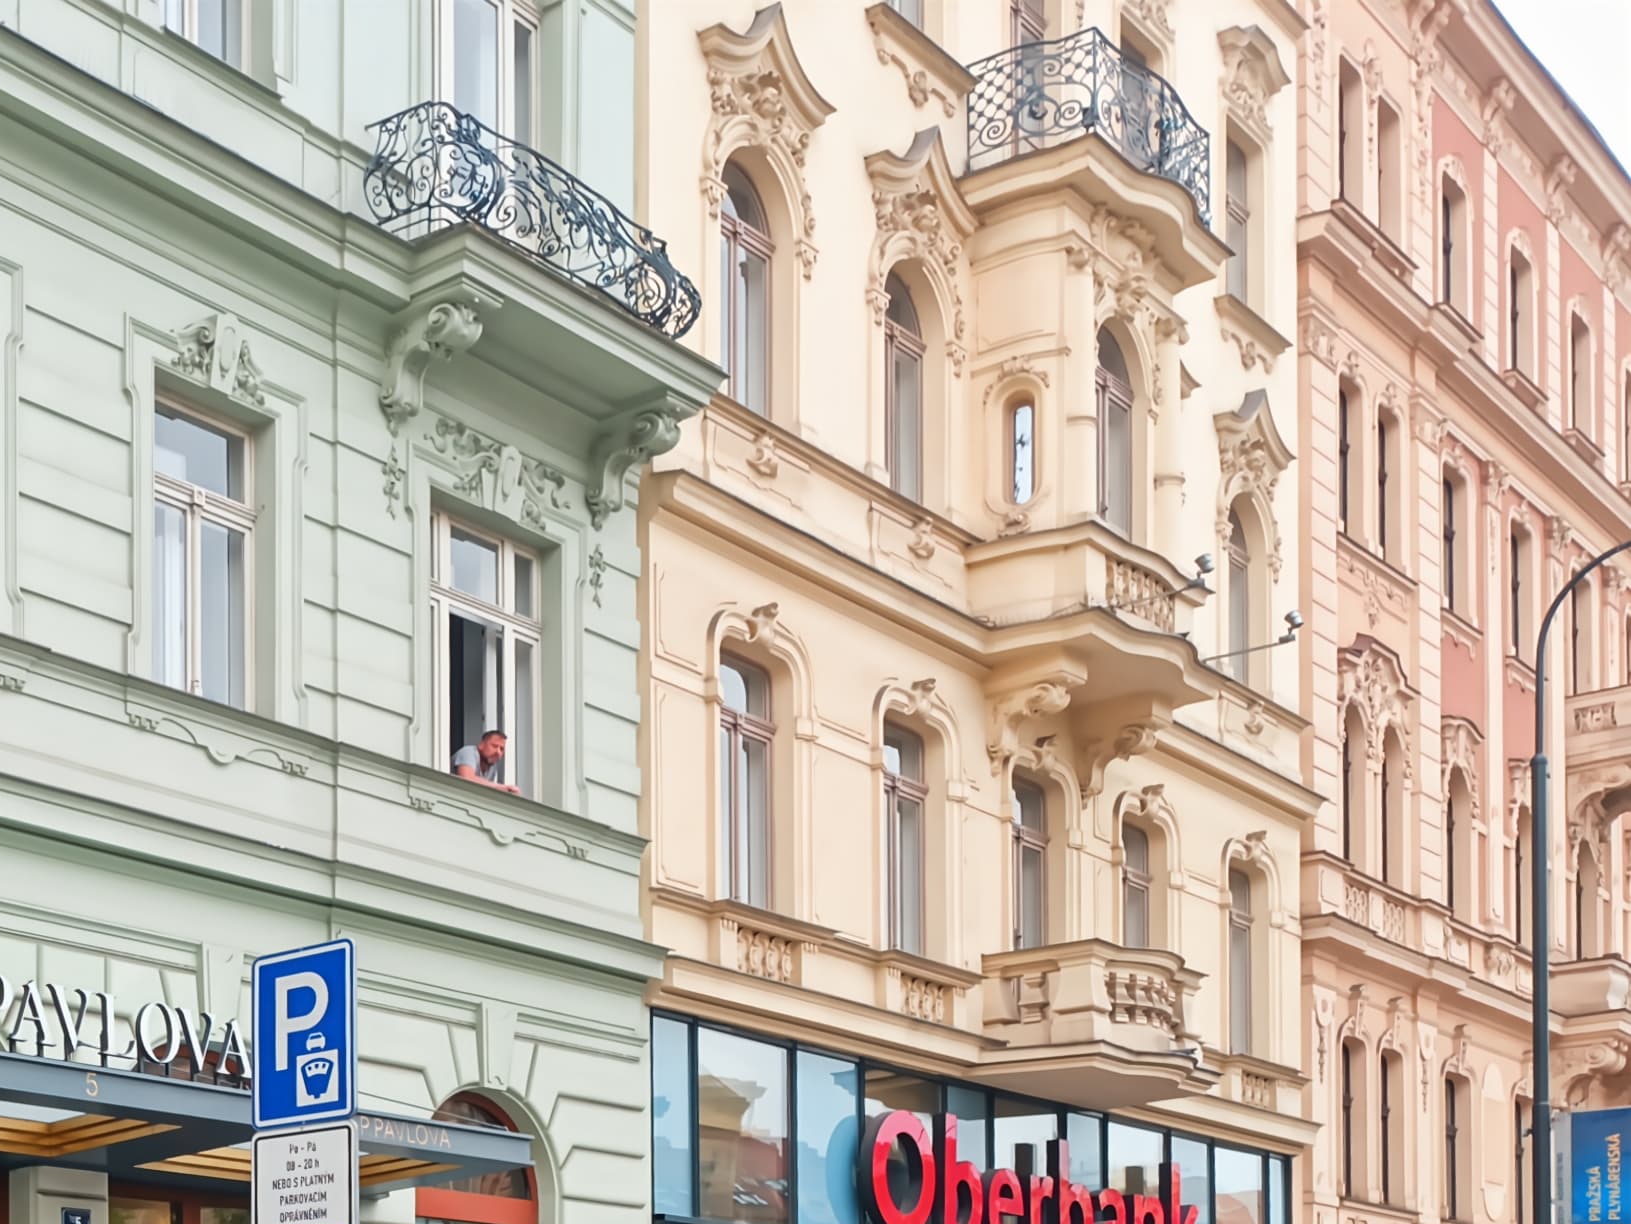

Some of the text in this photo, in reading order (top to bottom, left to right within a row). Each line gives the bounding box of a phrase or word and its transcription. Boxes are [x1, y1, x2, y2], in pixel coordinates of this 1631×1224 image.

[274, 970, 330, 1073] P
[84, 1071, 100, 1097] 5
[272, 1178, 292, 1191] NEBO
[293, 1176, 299, 1188] S
[1584, 1165, 1601, 1222] PRAŽSKÁ
[1604, 1132, 1621, 1221] PLYNÁRENSKÁ
